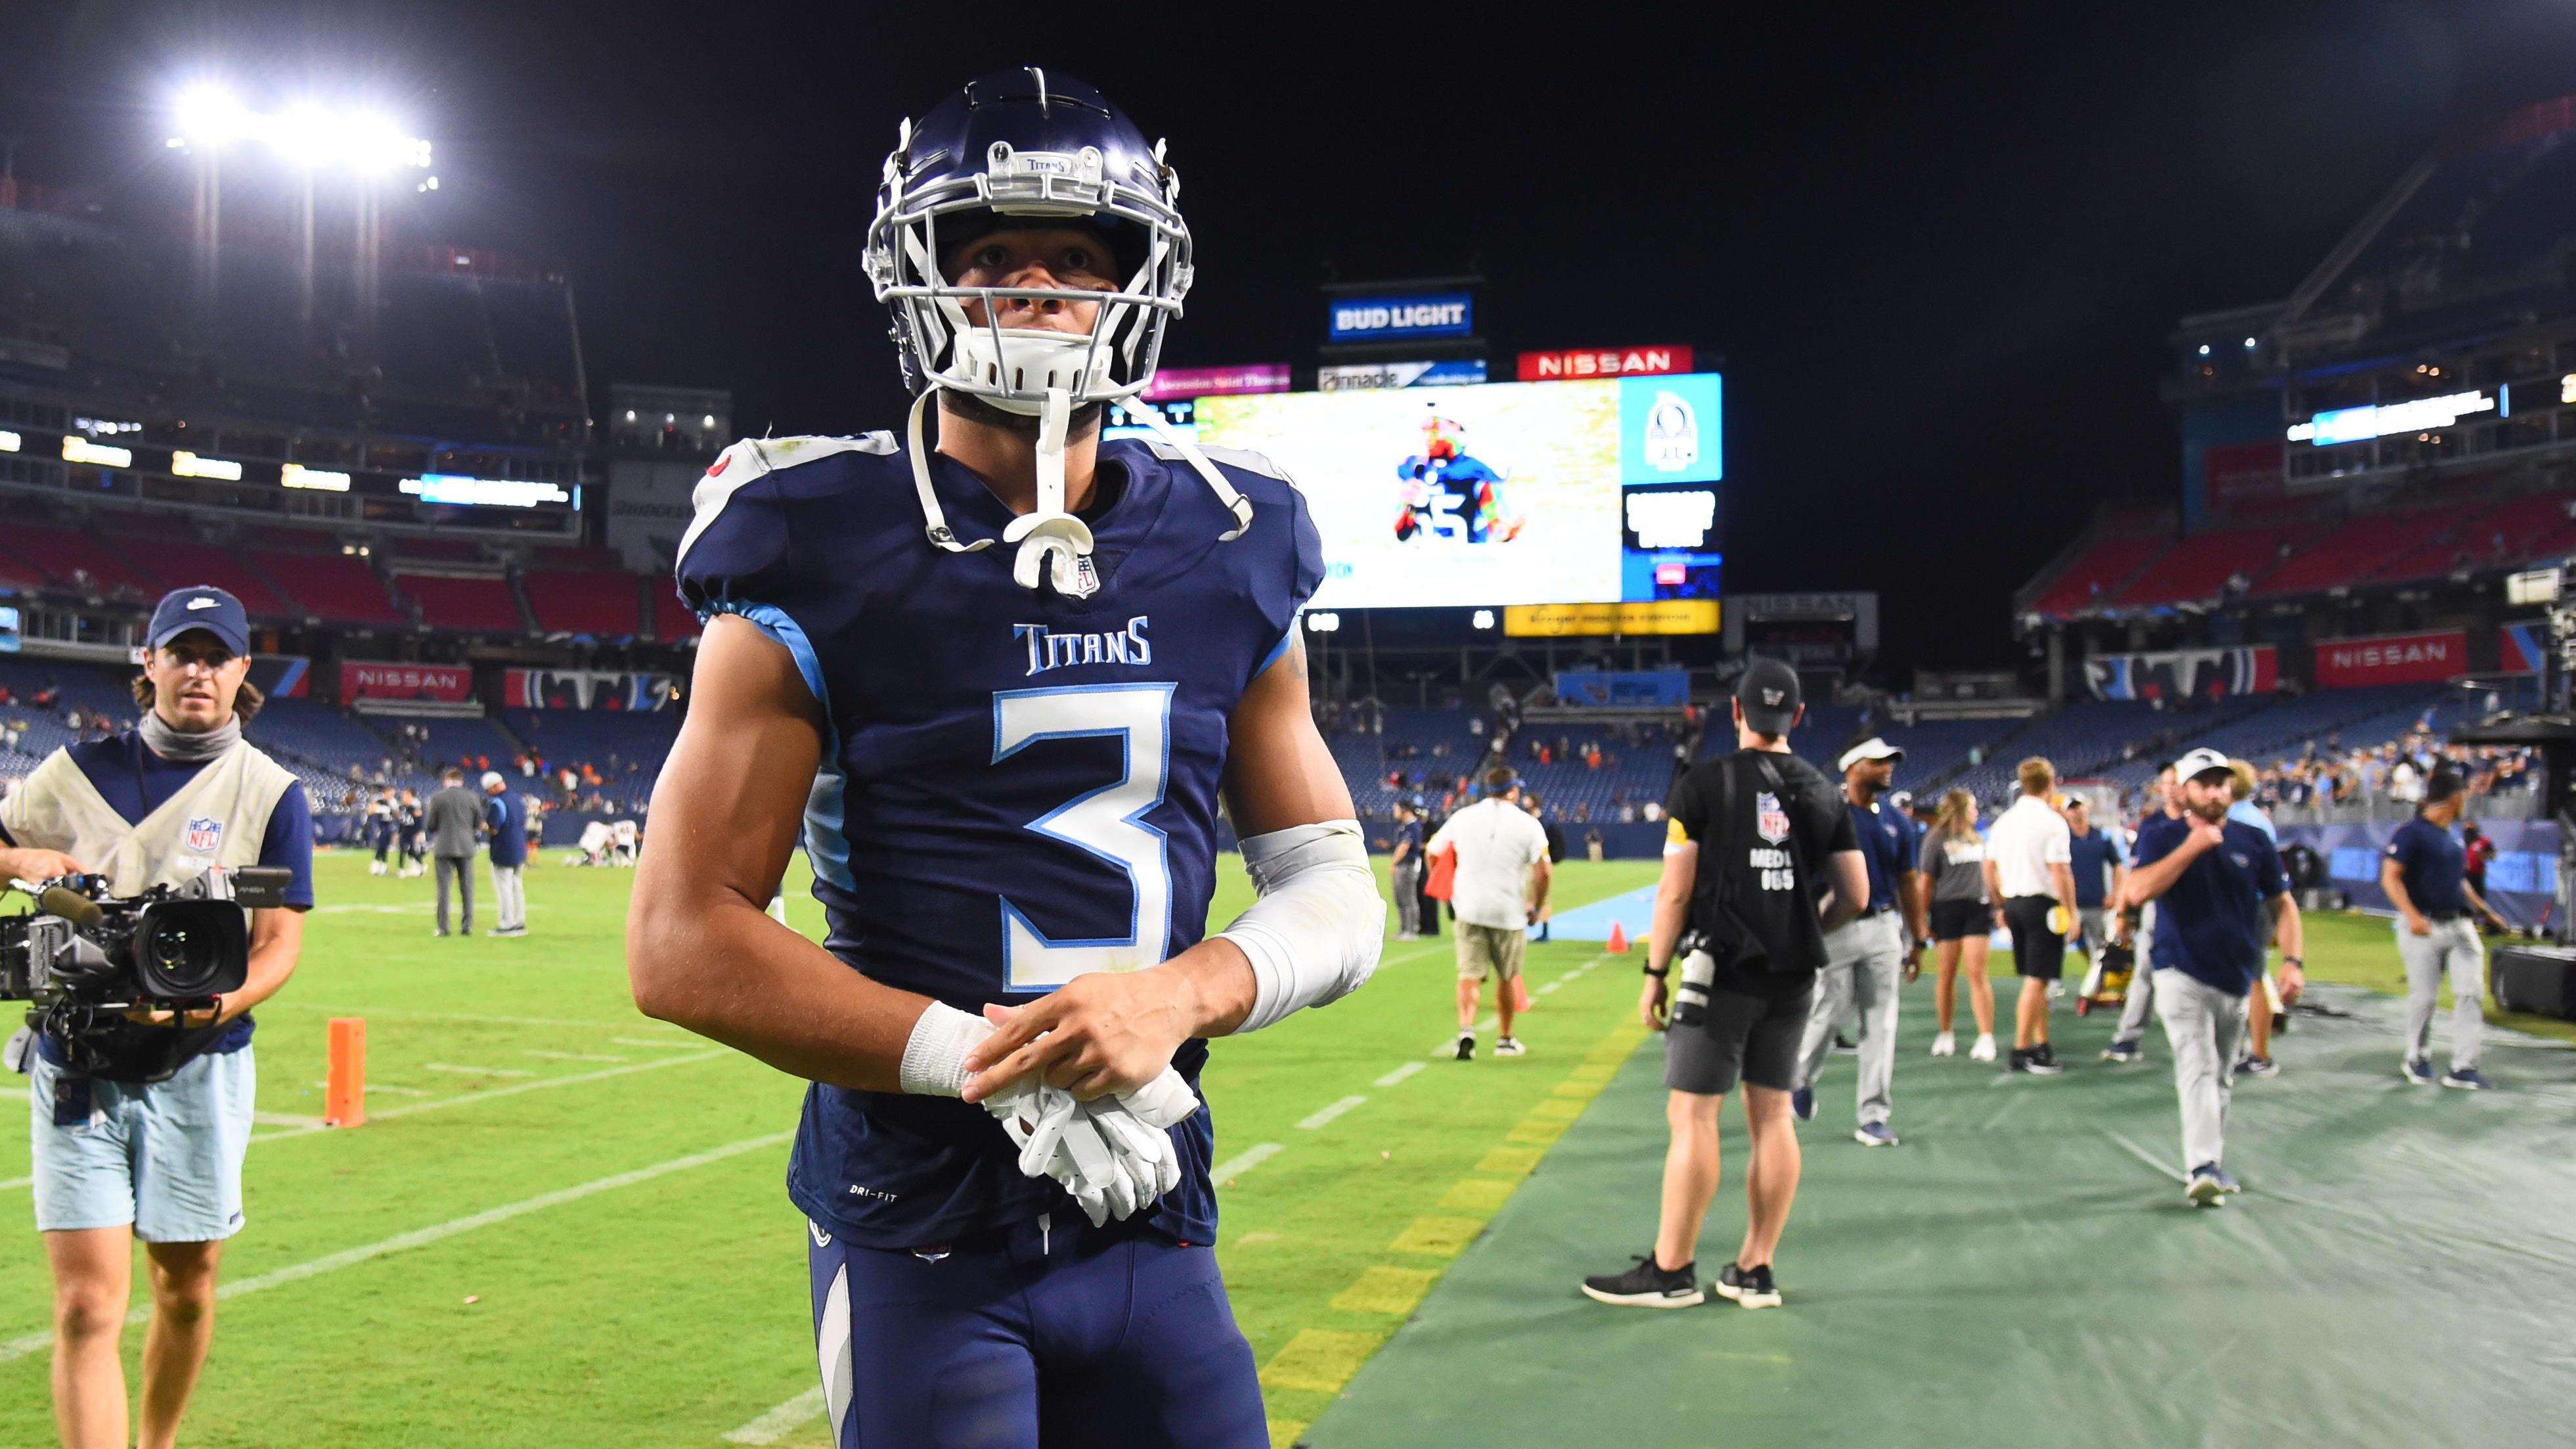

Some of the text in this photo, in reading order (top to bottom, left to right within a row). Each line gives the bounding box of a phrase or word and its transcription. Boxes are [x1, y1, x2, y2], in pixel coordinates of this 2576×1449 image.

[1336, 303, 1465, 330] BUD LIGHT
[1538, 350, 1671, 376] NISSAN
[1013, 615, 1152, 677] TITANS
[2333, 642, 2447, 668] NISSAN
[357, 669, 457, 689] NISSAN
[190, 831, 215, 848] NFL
[991, 682, 1179, 993] 3
[849, 1184, 898, 1203] DRI-FIT
